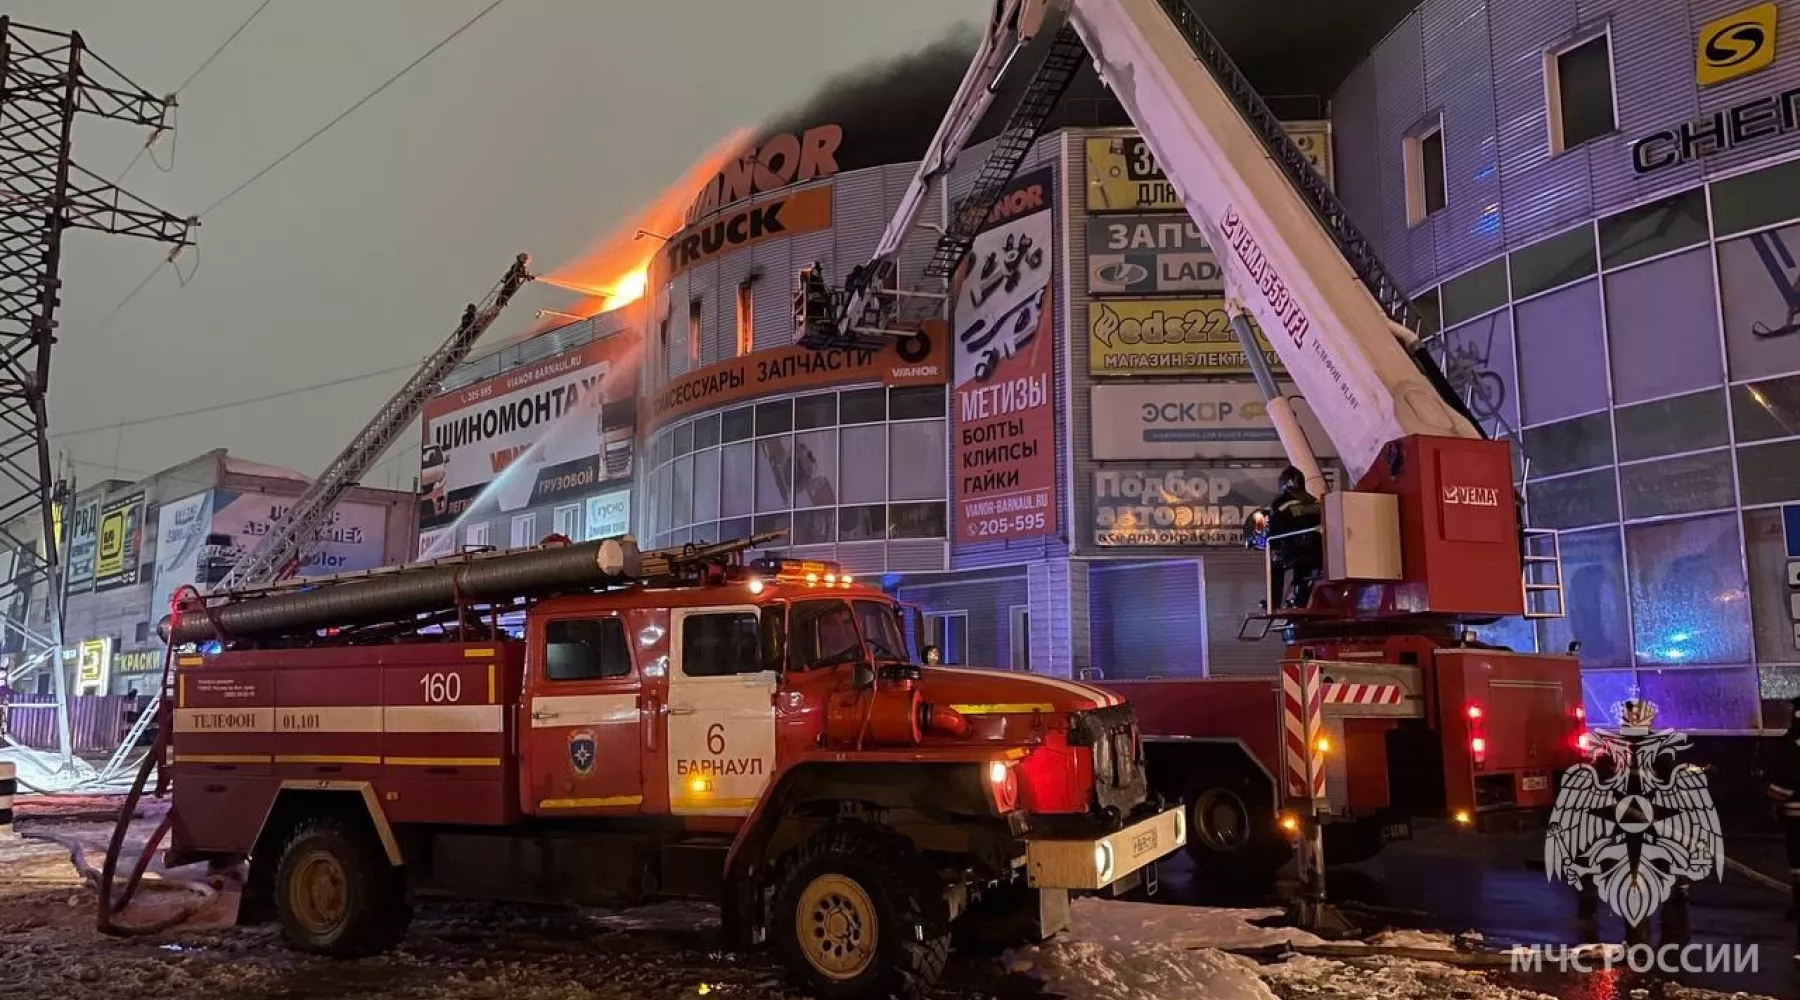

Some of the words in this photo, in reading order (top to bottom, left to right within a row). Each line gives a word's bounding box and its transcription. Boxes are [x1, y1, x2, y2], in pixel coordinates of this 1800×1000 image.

[1136, 183, 1176, 206] ДЛЯ
[668, 201, 786, 274] TRUCK
[1232, 220, 1268, 286] VEMA
[756, 348, 873, 382] ЗАПЧАСТИ
[892, 365, 939, 378] VIANOR
[1104, 353, 1182, 367] МАГАЗИН
[962, 372, 1047, 422] МЕТИЗЫ
[436, 373, 606, 451] ШИНОМОНТАЖ
[1142, 402, 1233, 422] ЭСКОР
[962, 419, 1024, 446] БОЛТЫ
[963, 440, 1038, 470] КЛИПСЫ
[539, 465, 594, 495] ГРУЗОВОЙ
[963, 469, 1020, 494] ГАЙКИ
[1096, 469, 1231, 504] Подбор
[965, 493, 1048, 518] VIANOR-BARNAUL.RU
[1460, 486, 1498, 506] VEMA
[979, 513, 1045, 536] 205-595
[1127, 530, 1156, 544] для
[1159, 529, 1226, 544] окраски
[120, 651, 160, 672] КРАСКИ
[420, 672, 461, 702] 160
[192, 714, 256, 729] ТЕЛЕФОН
[707, 723, 725, 754] 6
[677, 758, 763, 776] БАРНАУЛ
